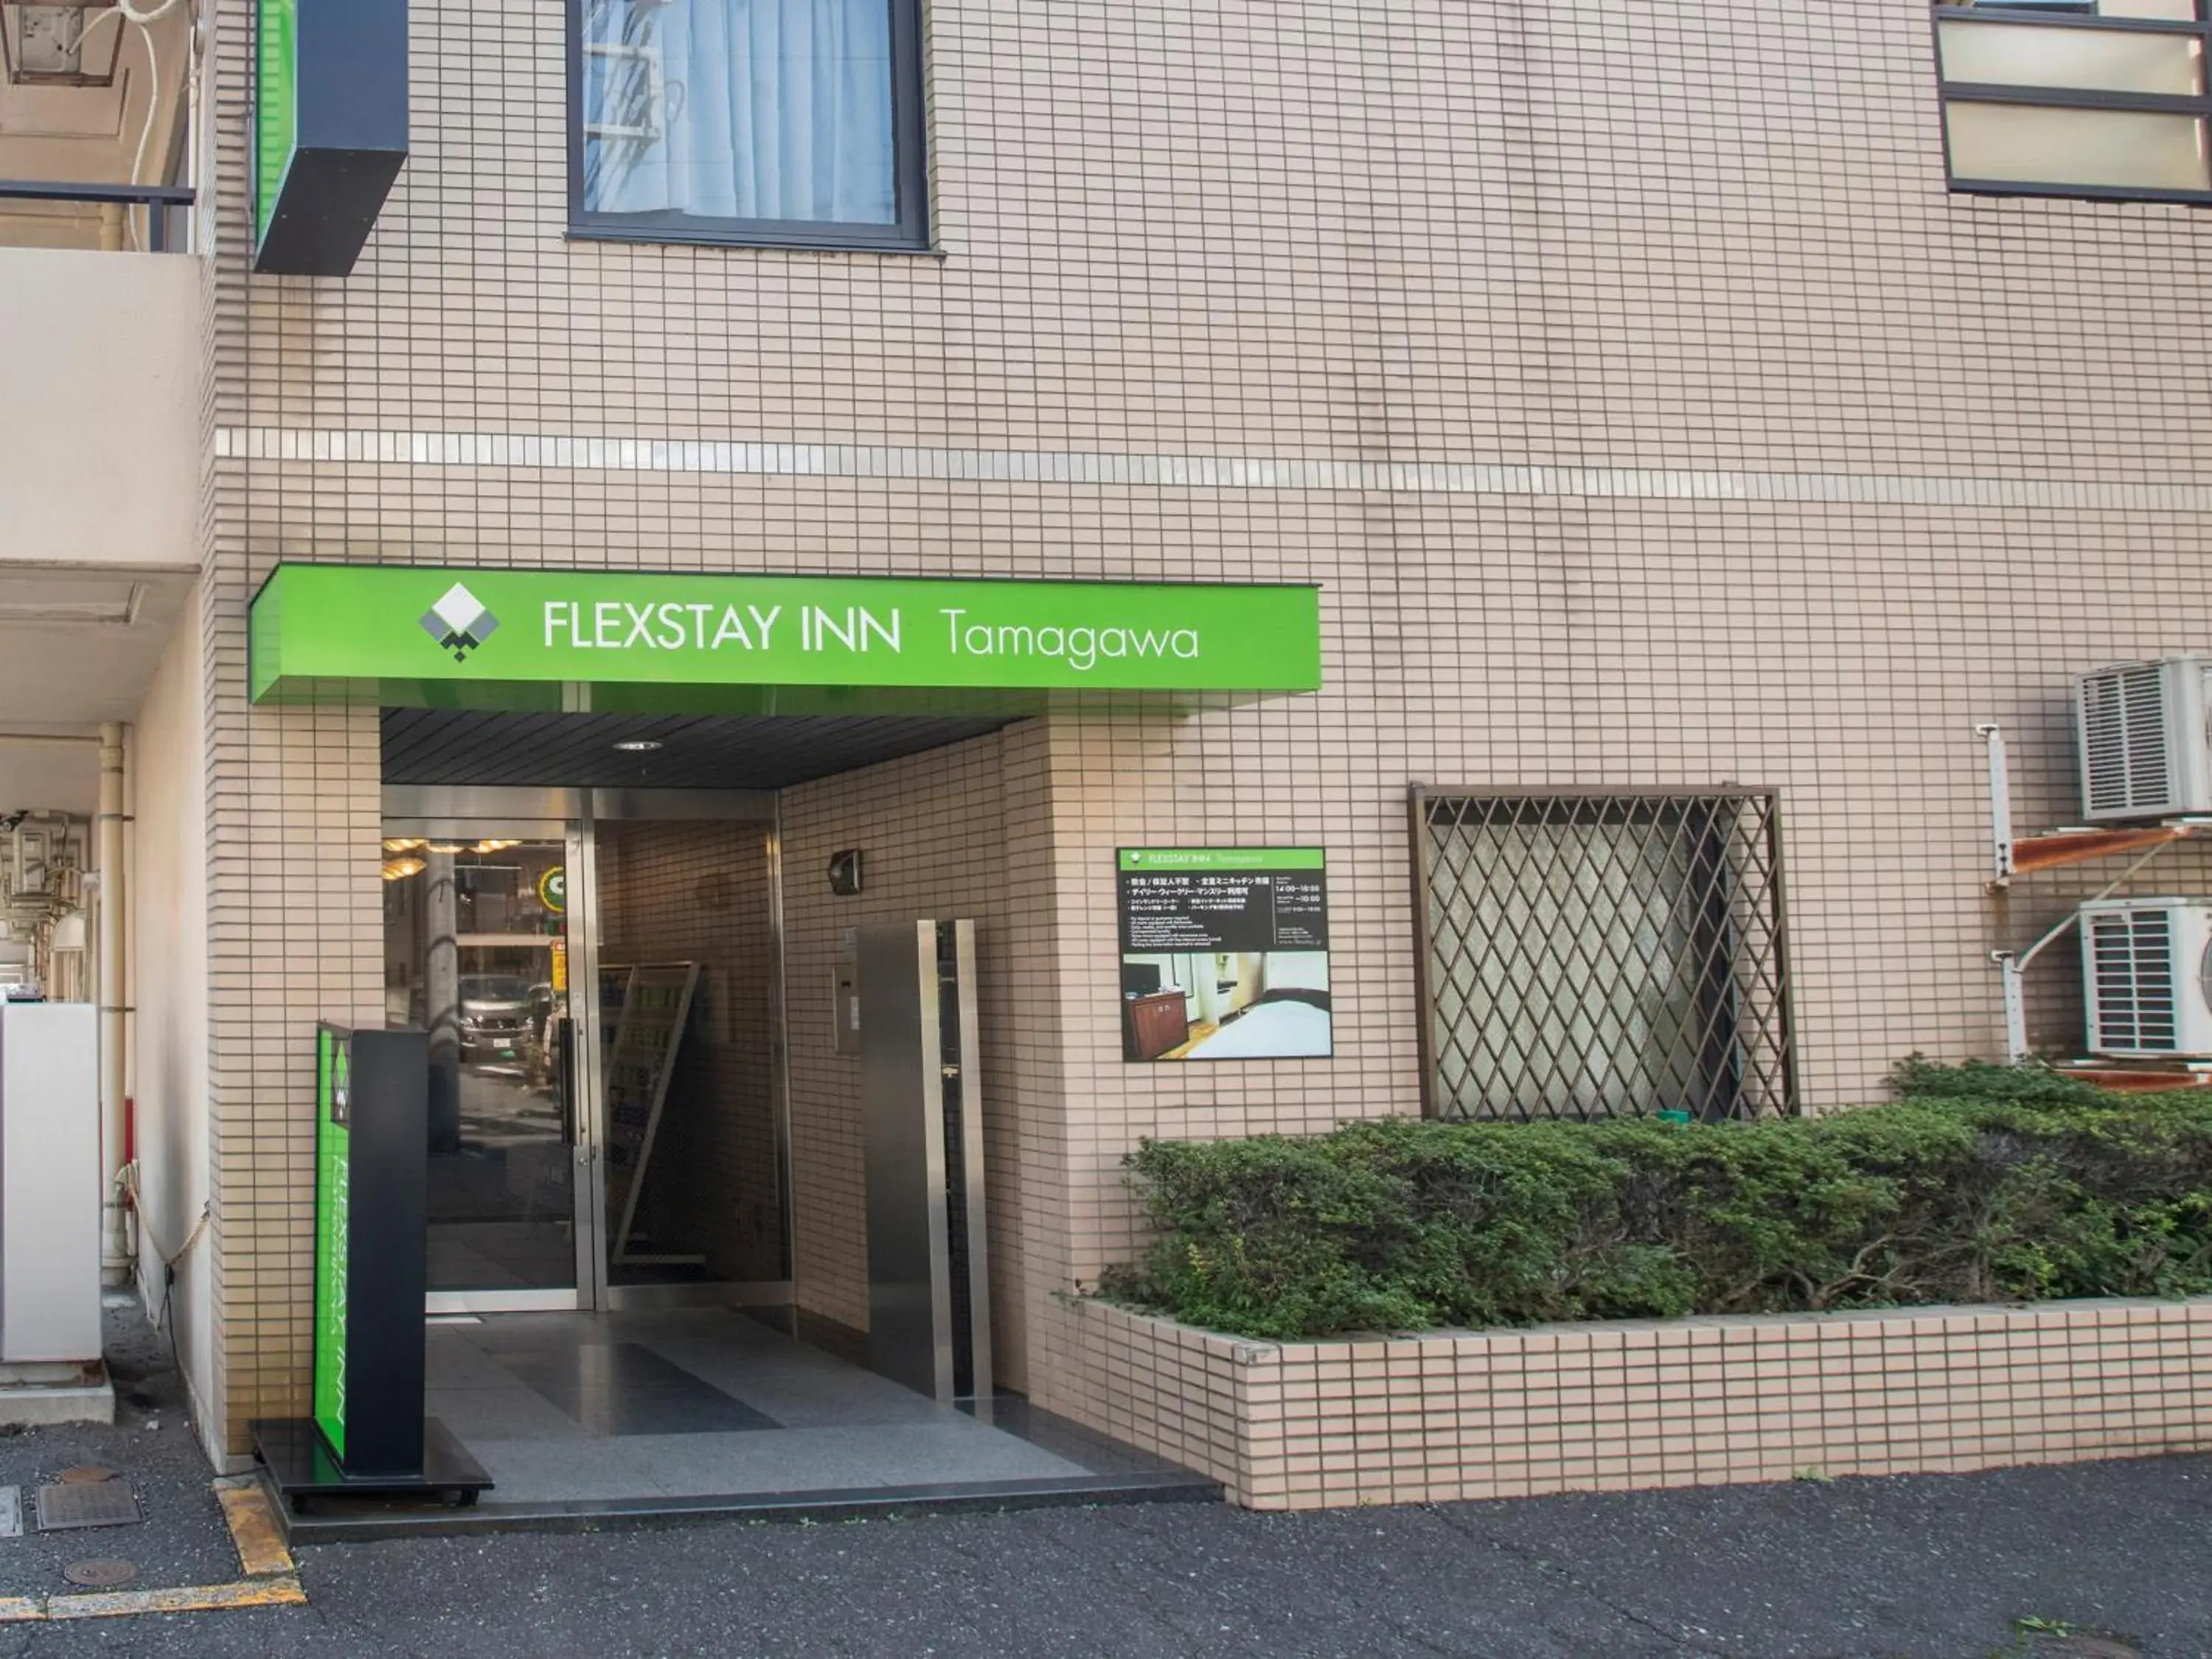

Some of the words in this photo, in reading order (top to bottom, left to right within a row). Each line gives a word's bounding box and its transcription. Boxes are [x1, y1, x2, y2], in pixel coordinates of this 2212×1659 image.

[543, 601, 782, 650] FLEXSTAY
[801, 605, 900, 653] INN
[940, 608, 1199, 670] Tamagawa
[336, 1344, 347, 1426] INN
